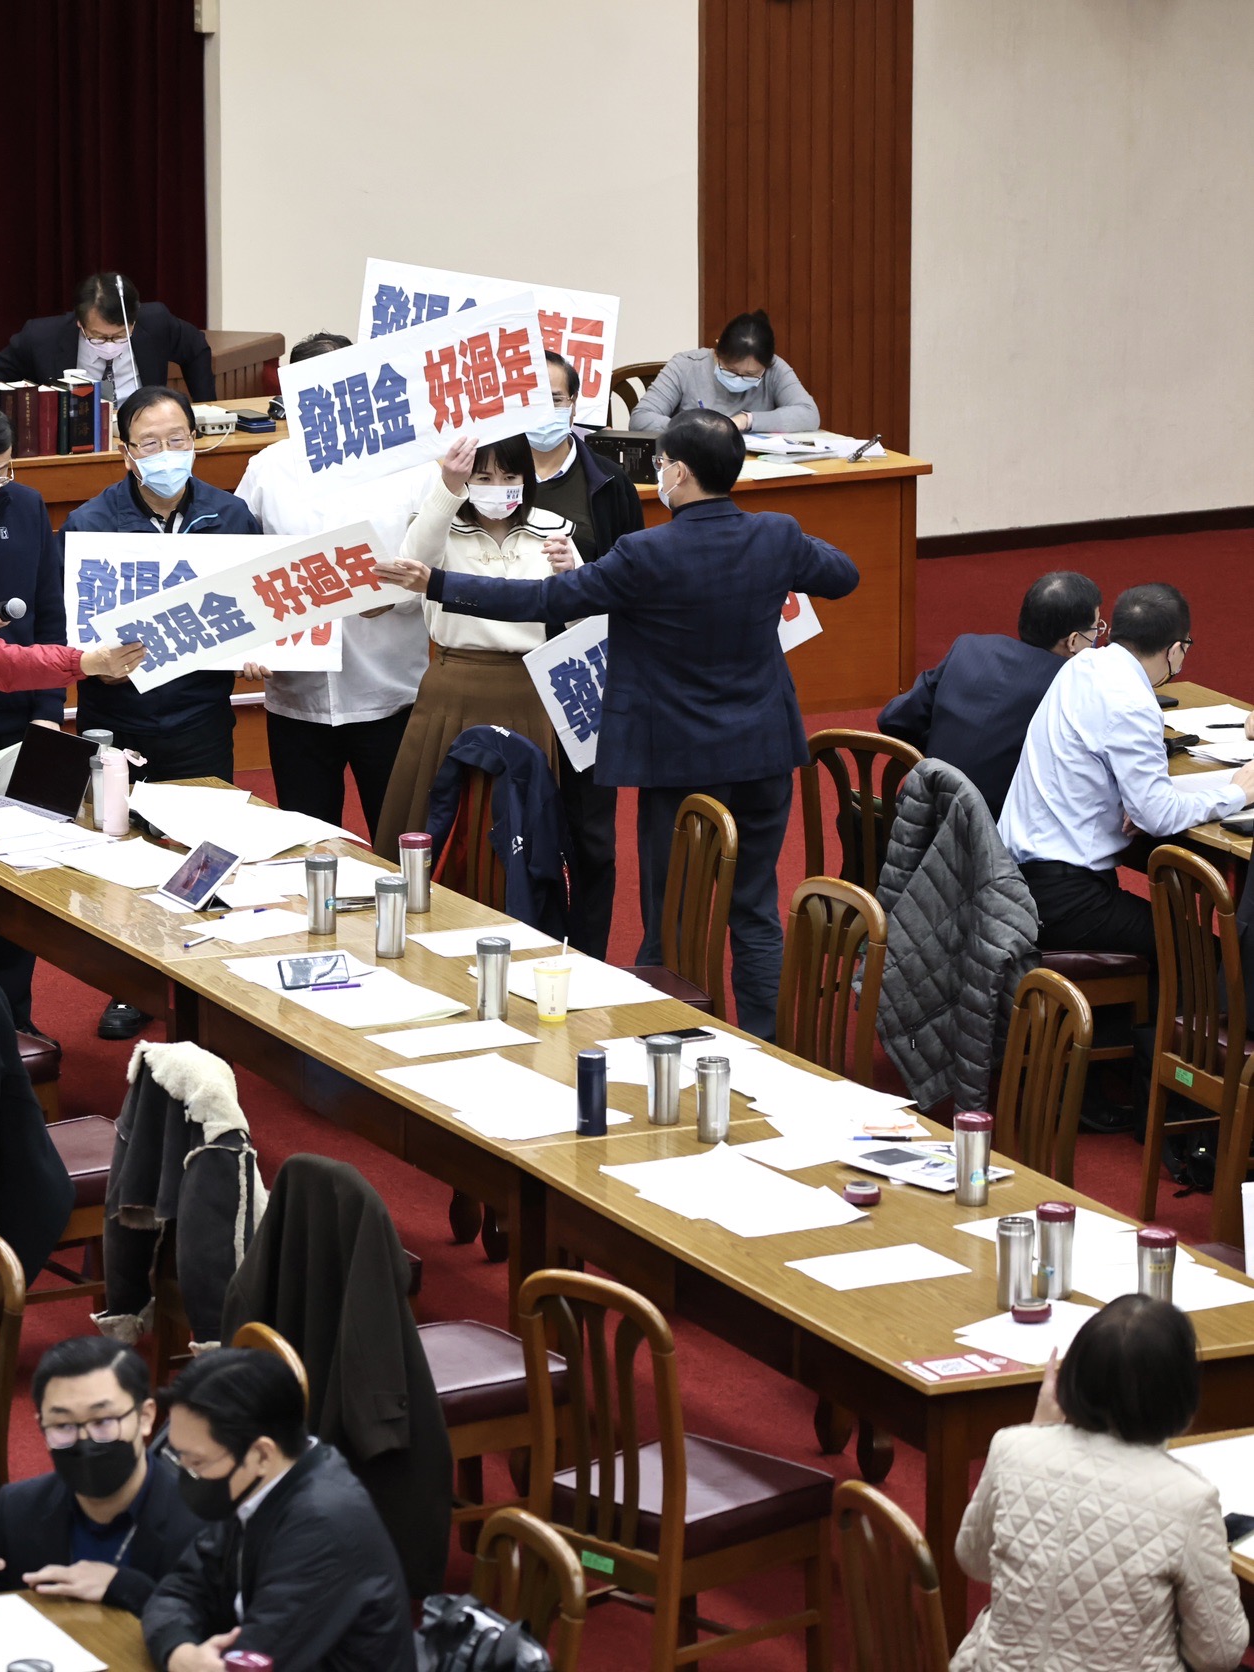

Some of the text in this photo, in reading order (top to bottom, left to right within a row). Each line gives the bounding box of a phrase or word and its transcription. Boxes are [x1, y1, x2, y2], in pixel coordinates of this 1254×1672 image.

[297, 327, 538, 474] 發現金 好過年
[115, 543, 383, 674] 發現金 好過年
